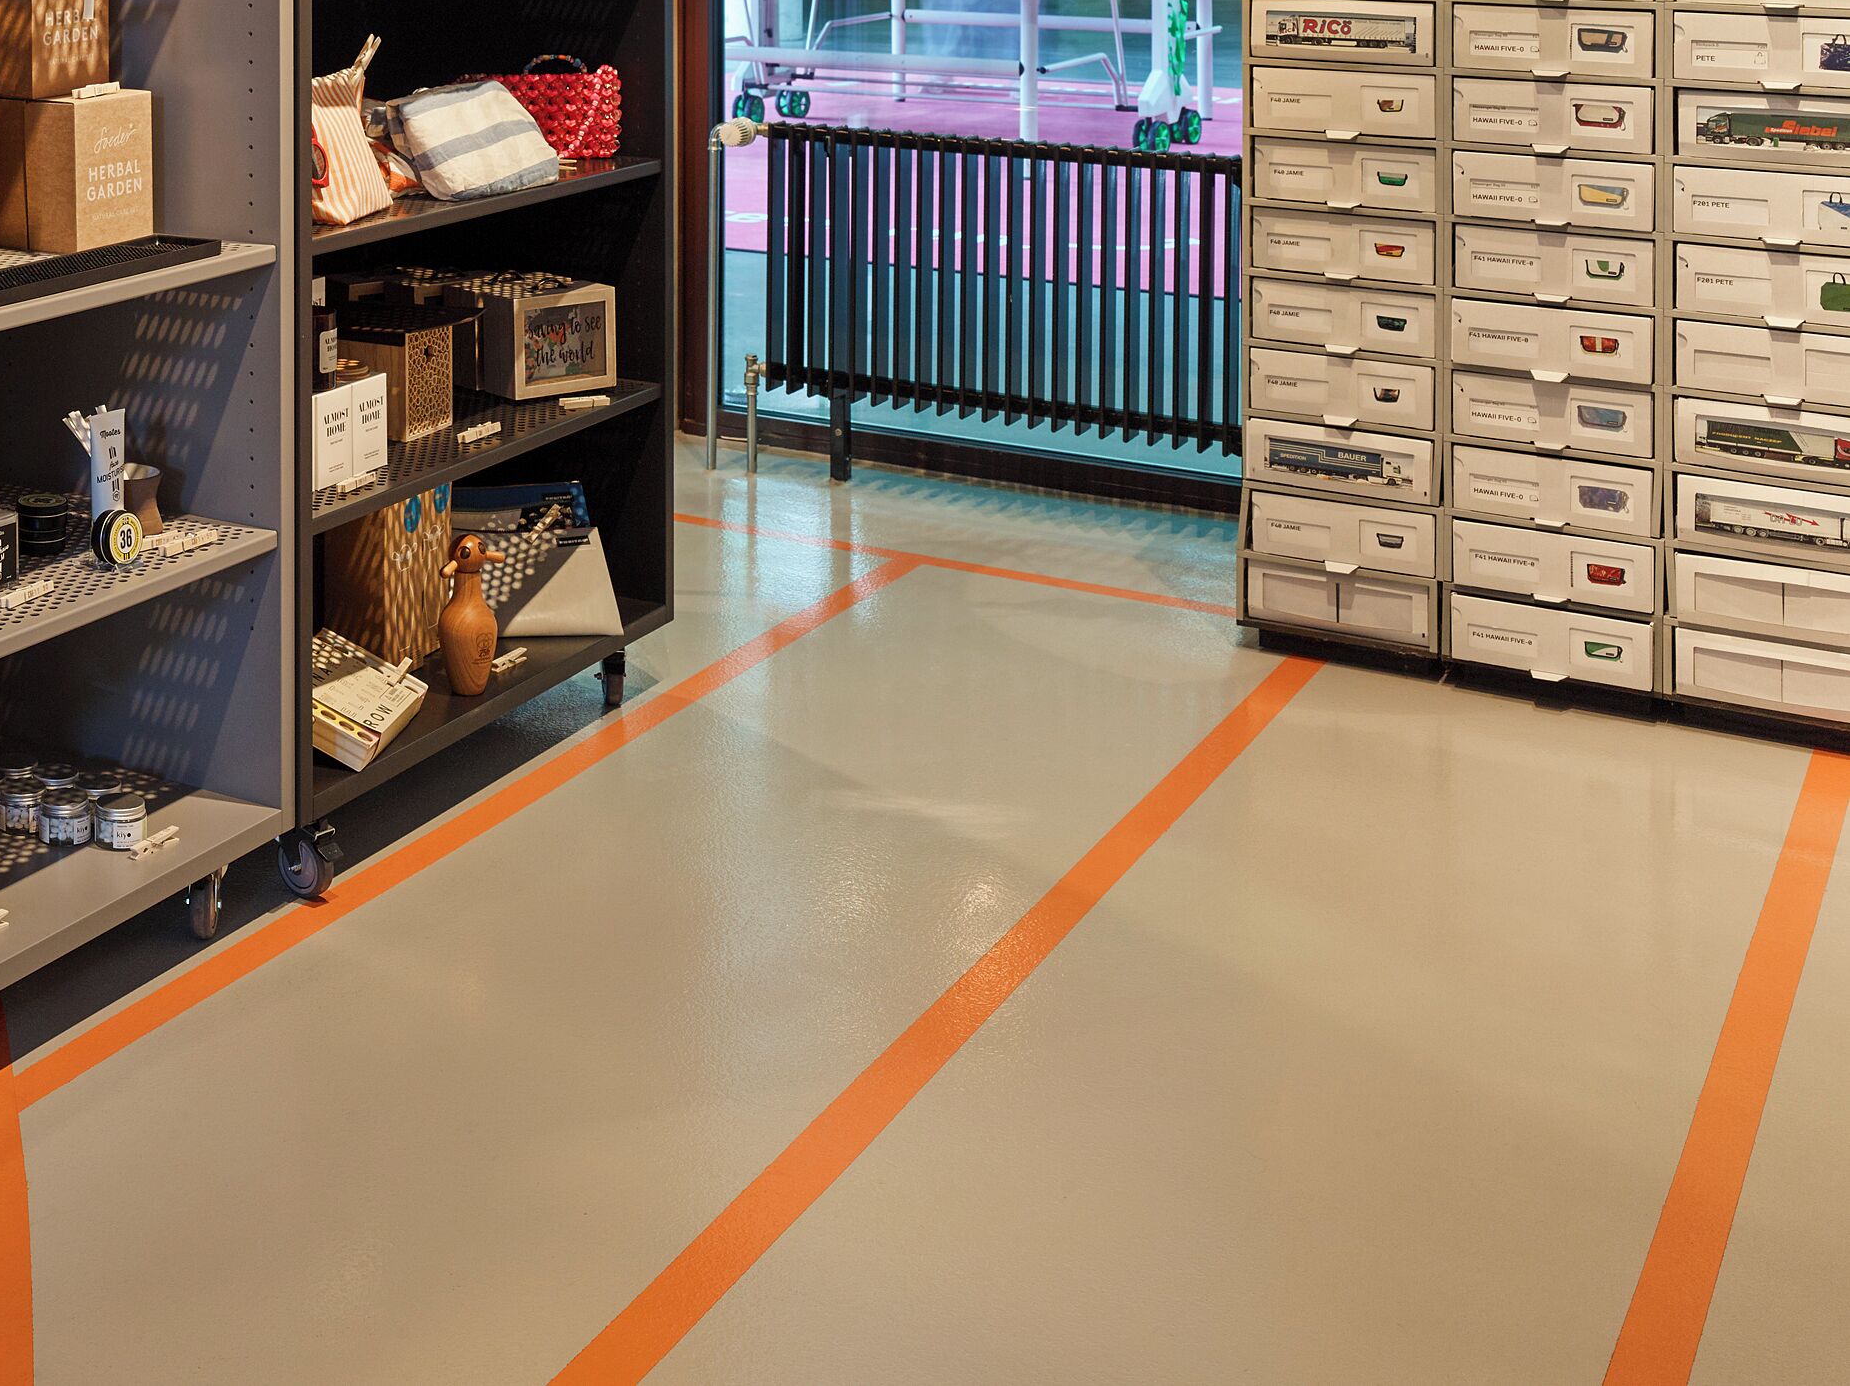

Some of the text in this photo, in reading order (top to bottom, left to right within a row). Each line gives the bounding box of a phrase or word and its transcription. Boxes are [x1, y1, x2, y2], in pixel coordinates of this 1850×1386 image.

[43, 25, 99, 46] GARDEN
[88, 159, 141, 183] HERBAL
[86, 177, 142, 202] GARDEN
[571, 320, 582, 333] to
[584, 315, 602, 330] see
[536, 340, 594, 364] the world
[358, 396, 384, 413] ALMOST
[323, 408, 349, 425] ALMOST
[361, 409, 382, 424] HOME
[326, 422, 347, 438] HOME
[1337, 451, 1367, 462] BAUER
[119, 528, 132, 549] 36
[1488, 555, 1512, 564] HAWAII
[1486, 633, 1509, 642] HAWAII
